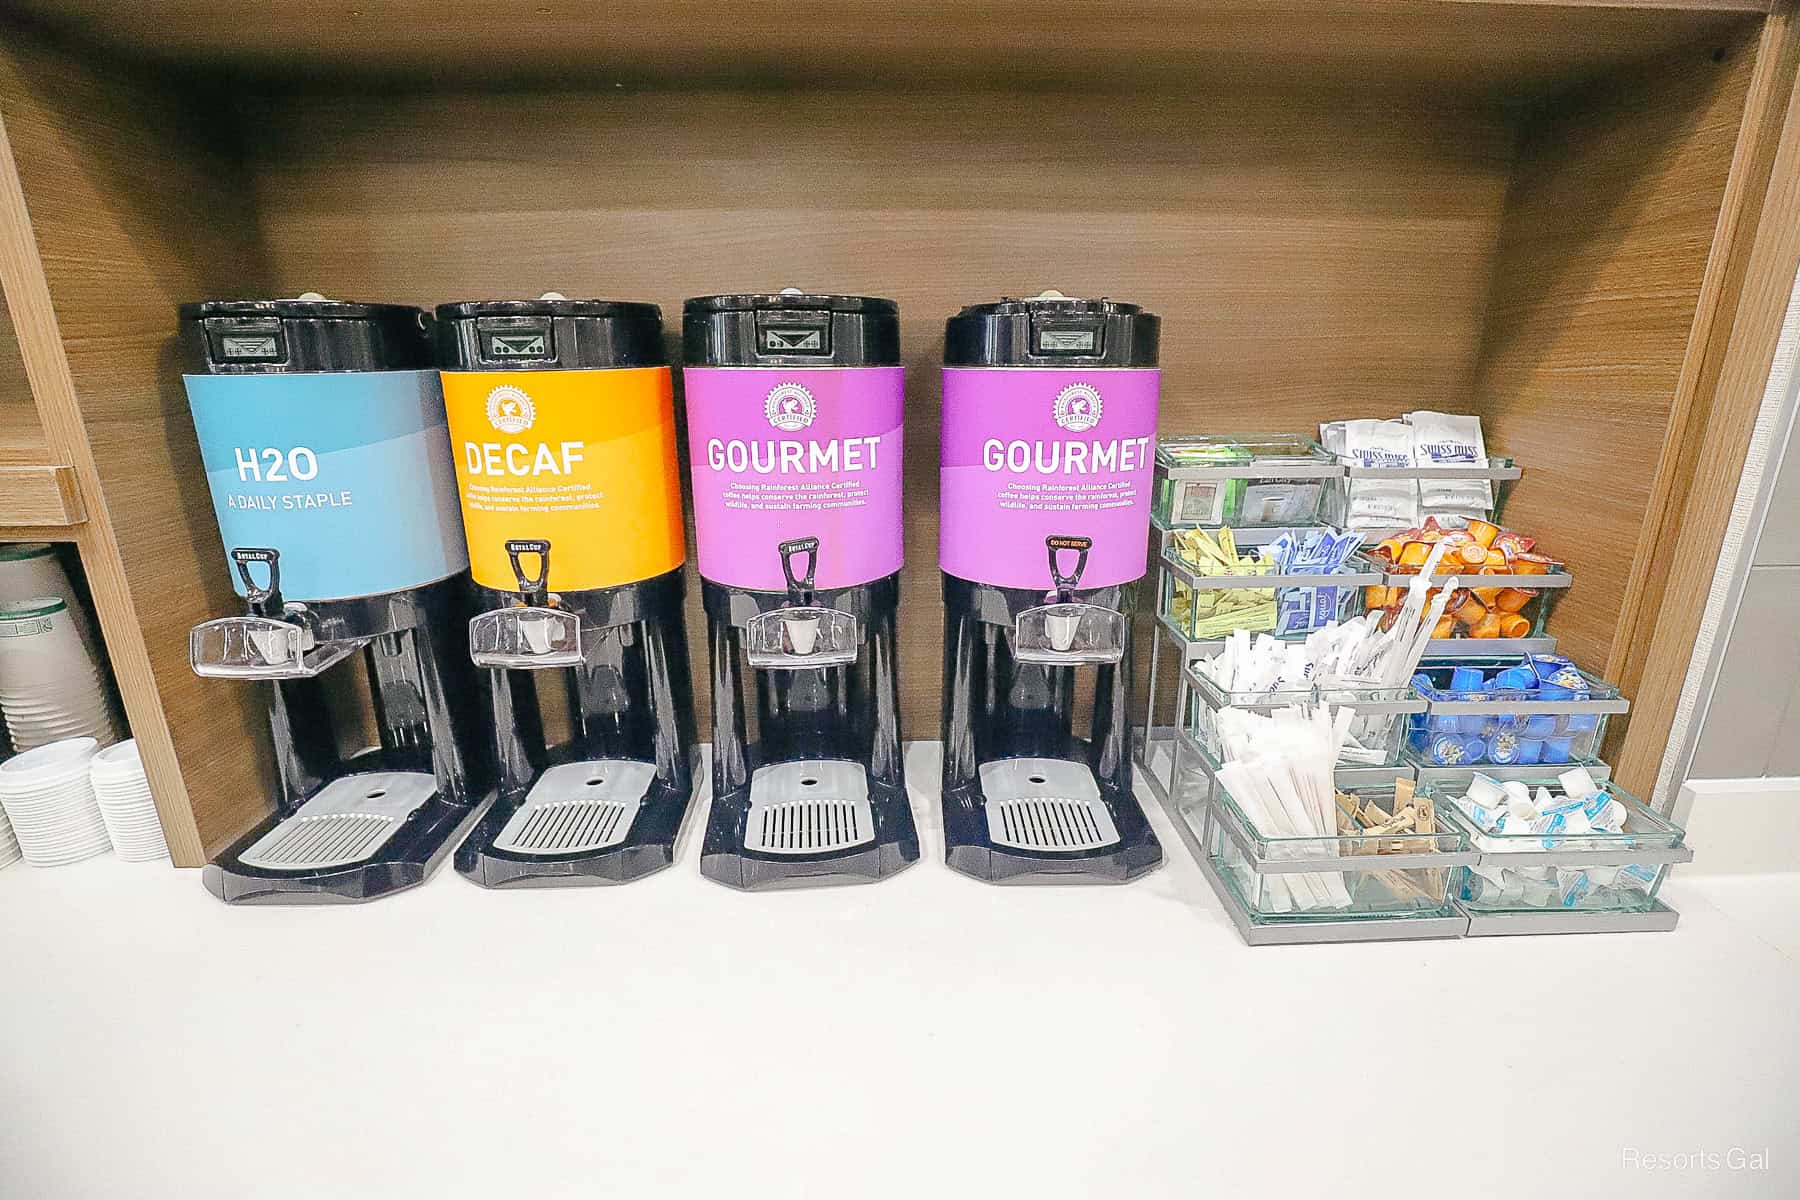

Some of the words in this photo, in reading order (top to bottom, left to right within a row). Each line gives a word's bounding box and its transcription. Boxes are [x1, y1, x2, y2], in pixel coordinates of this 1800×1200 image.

[465, 440, 585, 477] DECAF
[707, 436, 882, 475] GOURMET
[982, 436, 1150, 475] GOURMET
[234, 446, 319, 482] H2O
[730, 482, 761, 491] Choosing
[760, 483, 800, 491] Rainforest
[800, 482, 830, 491] Alliance
[831, 480, 861, 490] Certified
[1007, 482, 1041, 492] Choosing
[1041, 483, 1080, 492] Rainforest
[1080, 483, 1108, 492] Alliance
[227, 494, 237, 509] A
[238, 495, 277, 511] DAILY
[281, 490, 353, 510] STAPLE
[741, 491, 760, 501] helps
[761, 493, 794, 501] conserve
[795, 492, 807, 500] the
[808, 491, 846, 500] rainforest,
[998, 491, 1019, 500] coffee
[1019, 492, 1040, 502] helps
[1040, 494, 1074, 502] conserve
[1074, 492, 1086, 500] the
[750, 501, 764, 510] and
[764, 502, 793, 511] sustain
[793, 502, 822, 511] farming
[999, 501, 1028, 510] wildlife,
[1029, 502, 1042, 510] and
[1043, 502, 1070, 511] sustain
[1071, 502, 1100, 511] farming
